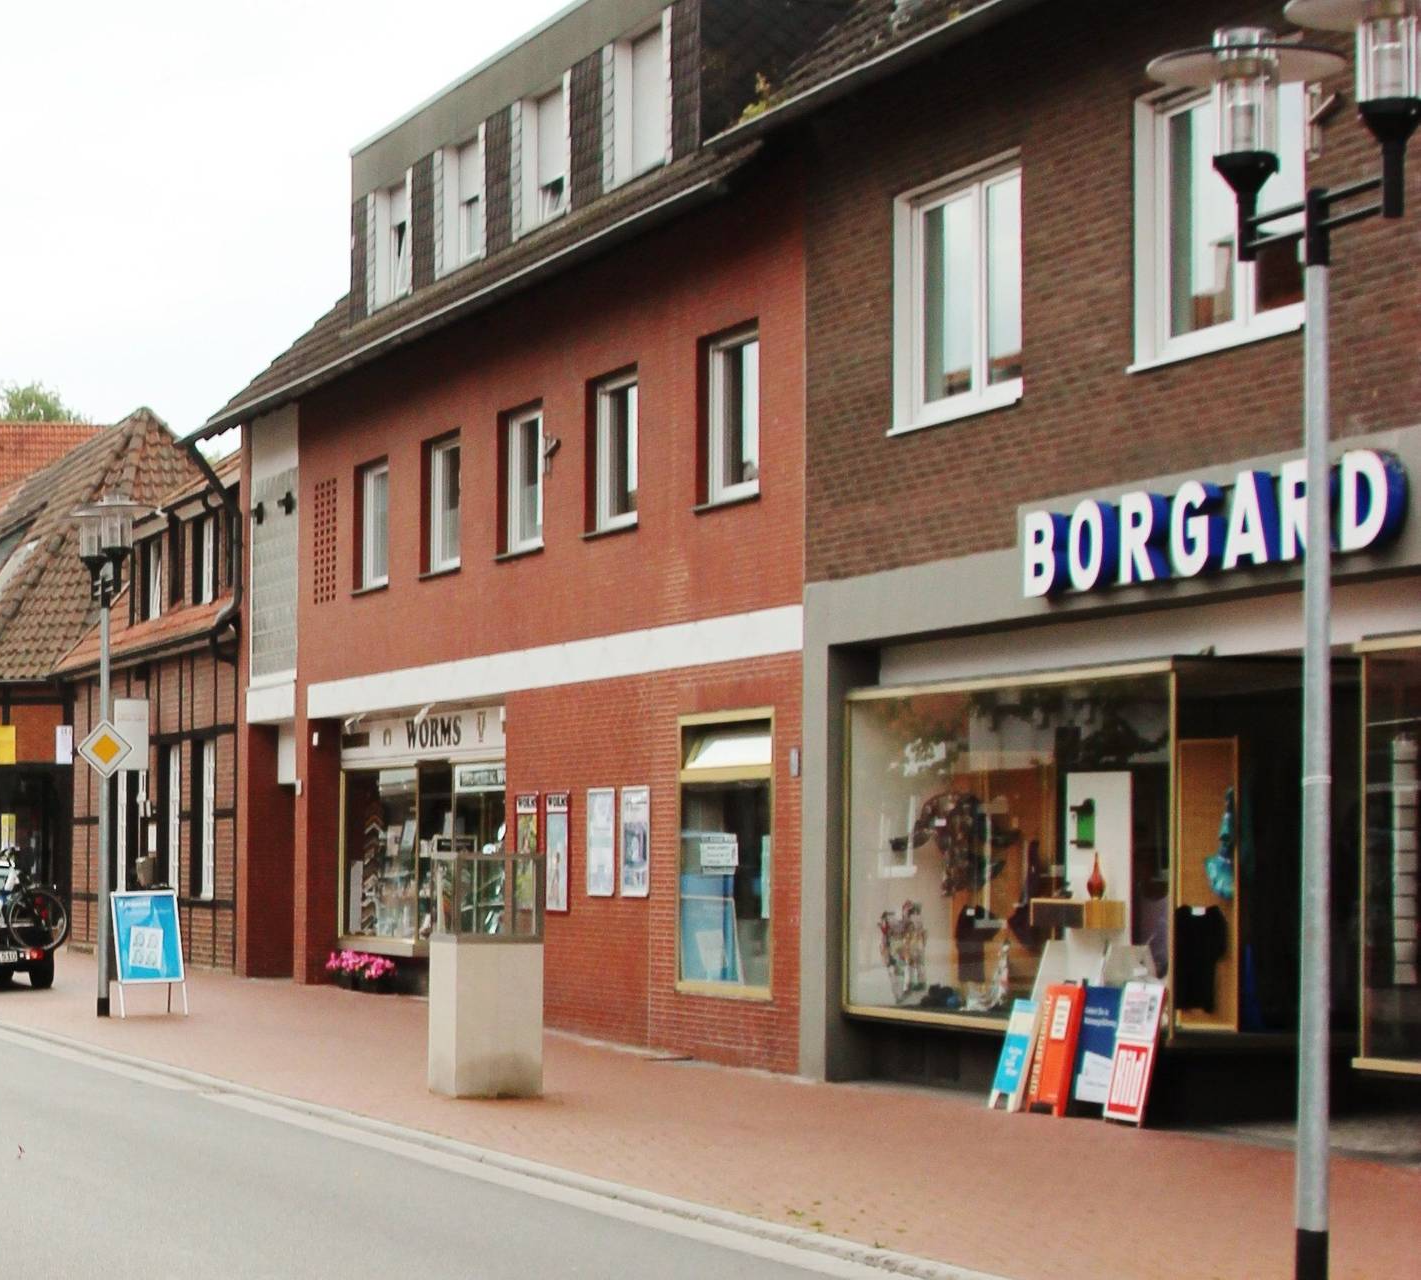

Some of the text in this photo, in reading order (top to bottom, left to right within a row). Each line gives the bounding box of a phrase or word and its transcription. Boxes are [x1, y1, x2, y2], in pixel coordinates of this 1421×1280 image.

[1024, 449, 1396, 598] BORGARD
[406, 714, 462, 749] WORMS
[1109, 1049, 1148, 1109] Bild
